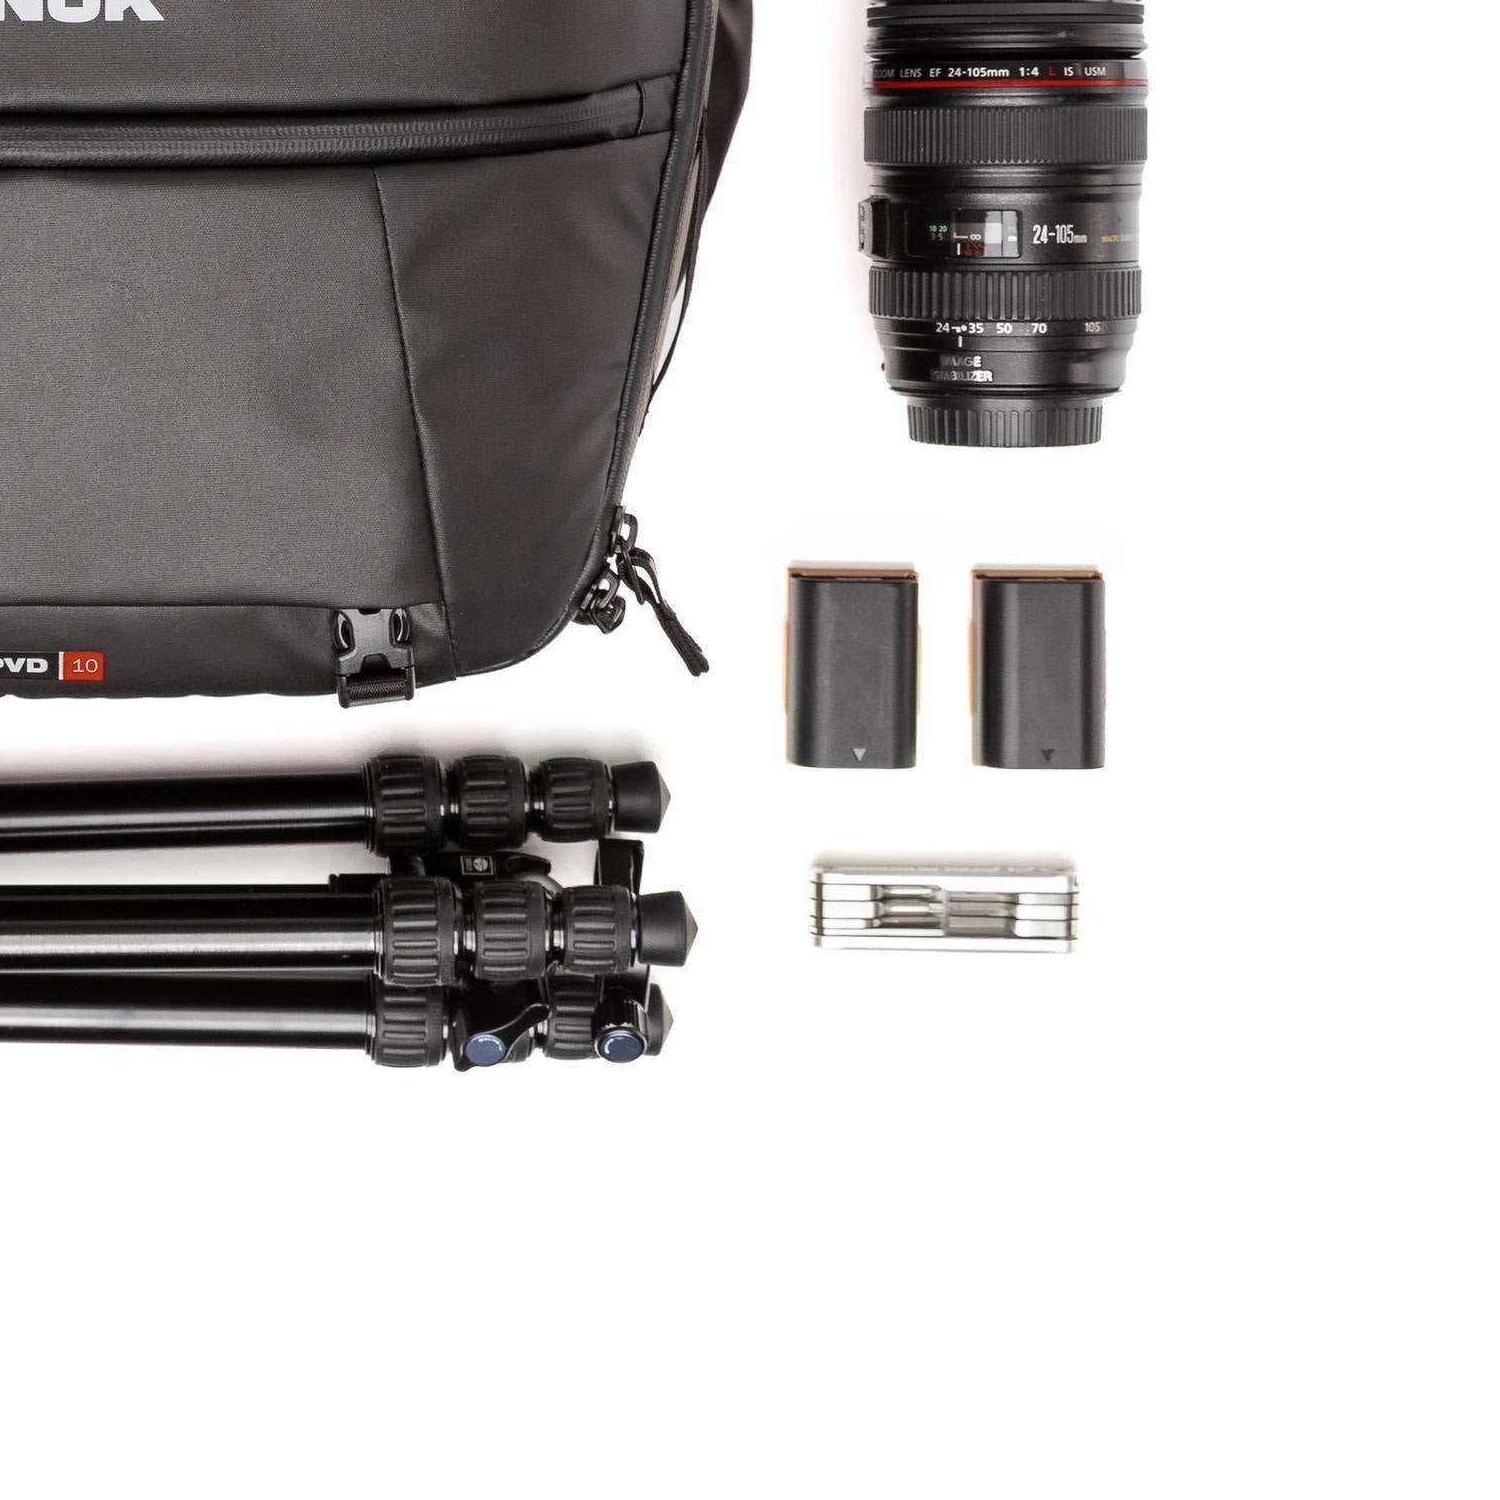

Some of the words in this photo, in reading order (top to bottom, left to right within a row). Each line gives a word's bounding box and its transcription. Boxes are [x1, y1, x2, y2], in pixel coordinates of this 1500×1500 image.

[900, 68, 922, 78] LENS
[929, 68, 942, 77] EF
[947, 67, 1010, 78] 24-105mm
[1019, 67, 1039, 77] 1:4
[1063, 67, 1075, 76] IS
[1084, 67, 1106, 76] USM
[936, 322, 950, 333] 24
[968, 322, 984, 334] 35
[996, 322, 1013, 334] 50
[1031, 322, 1047, 334] 70
[1084, 322, 1101, 333] 105
[940, 355, 982, 367] IMAGE
[72, 658, 99, 673] 10
